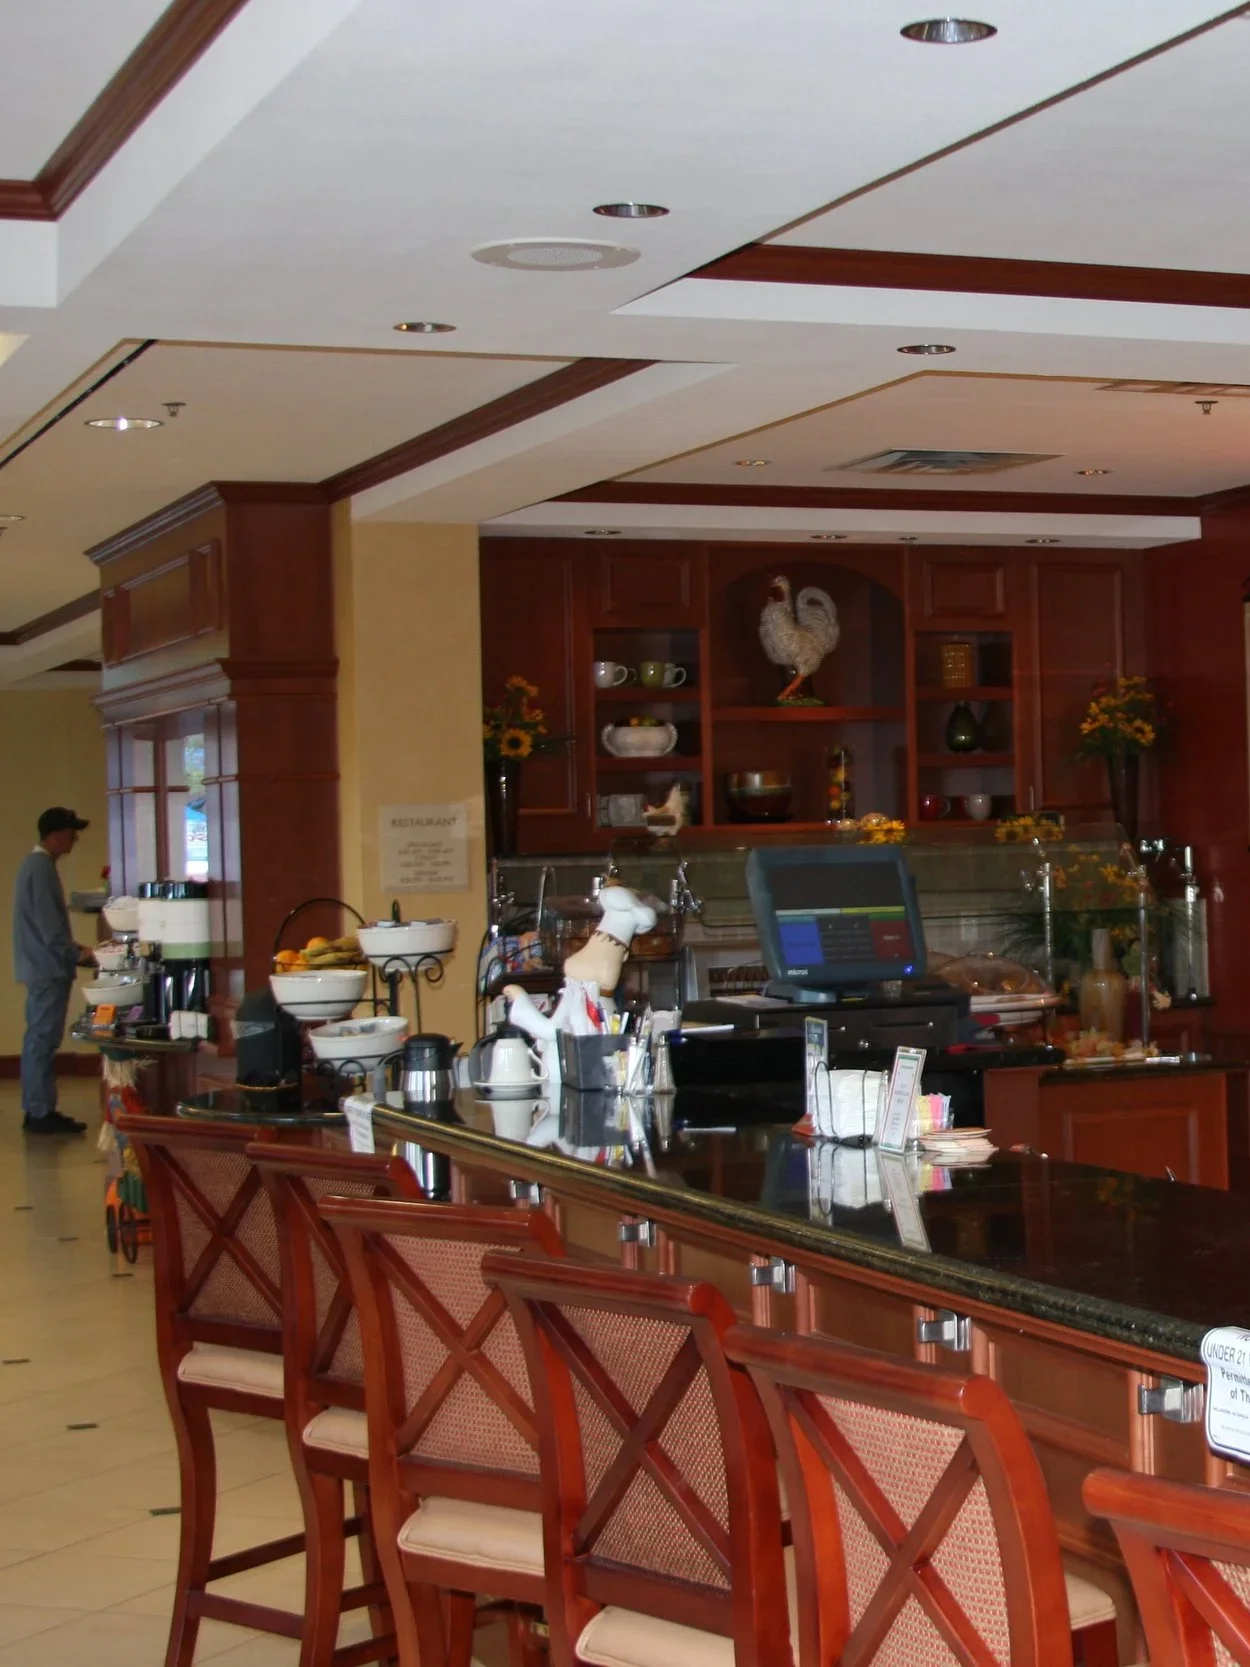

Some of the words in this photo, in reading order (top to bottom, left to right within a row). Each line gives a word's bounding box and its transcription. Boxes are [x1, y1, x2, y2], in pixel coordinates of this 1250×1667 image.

[1207, 1342, 1236, 1363] UNDER
[1237, 1349, 1246, 1366] 21
[1230, 1387, 1239, 1400] of
